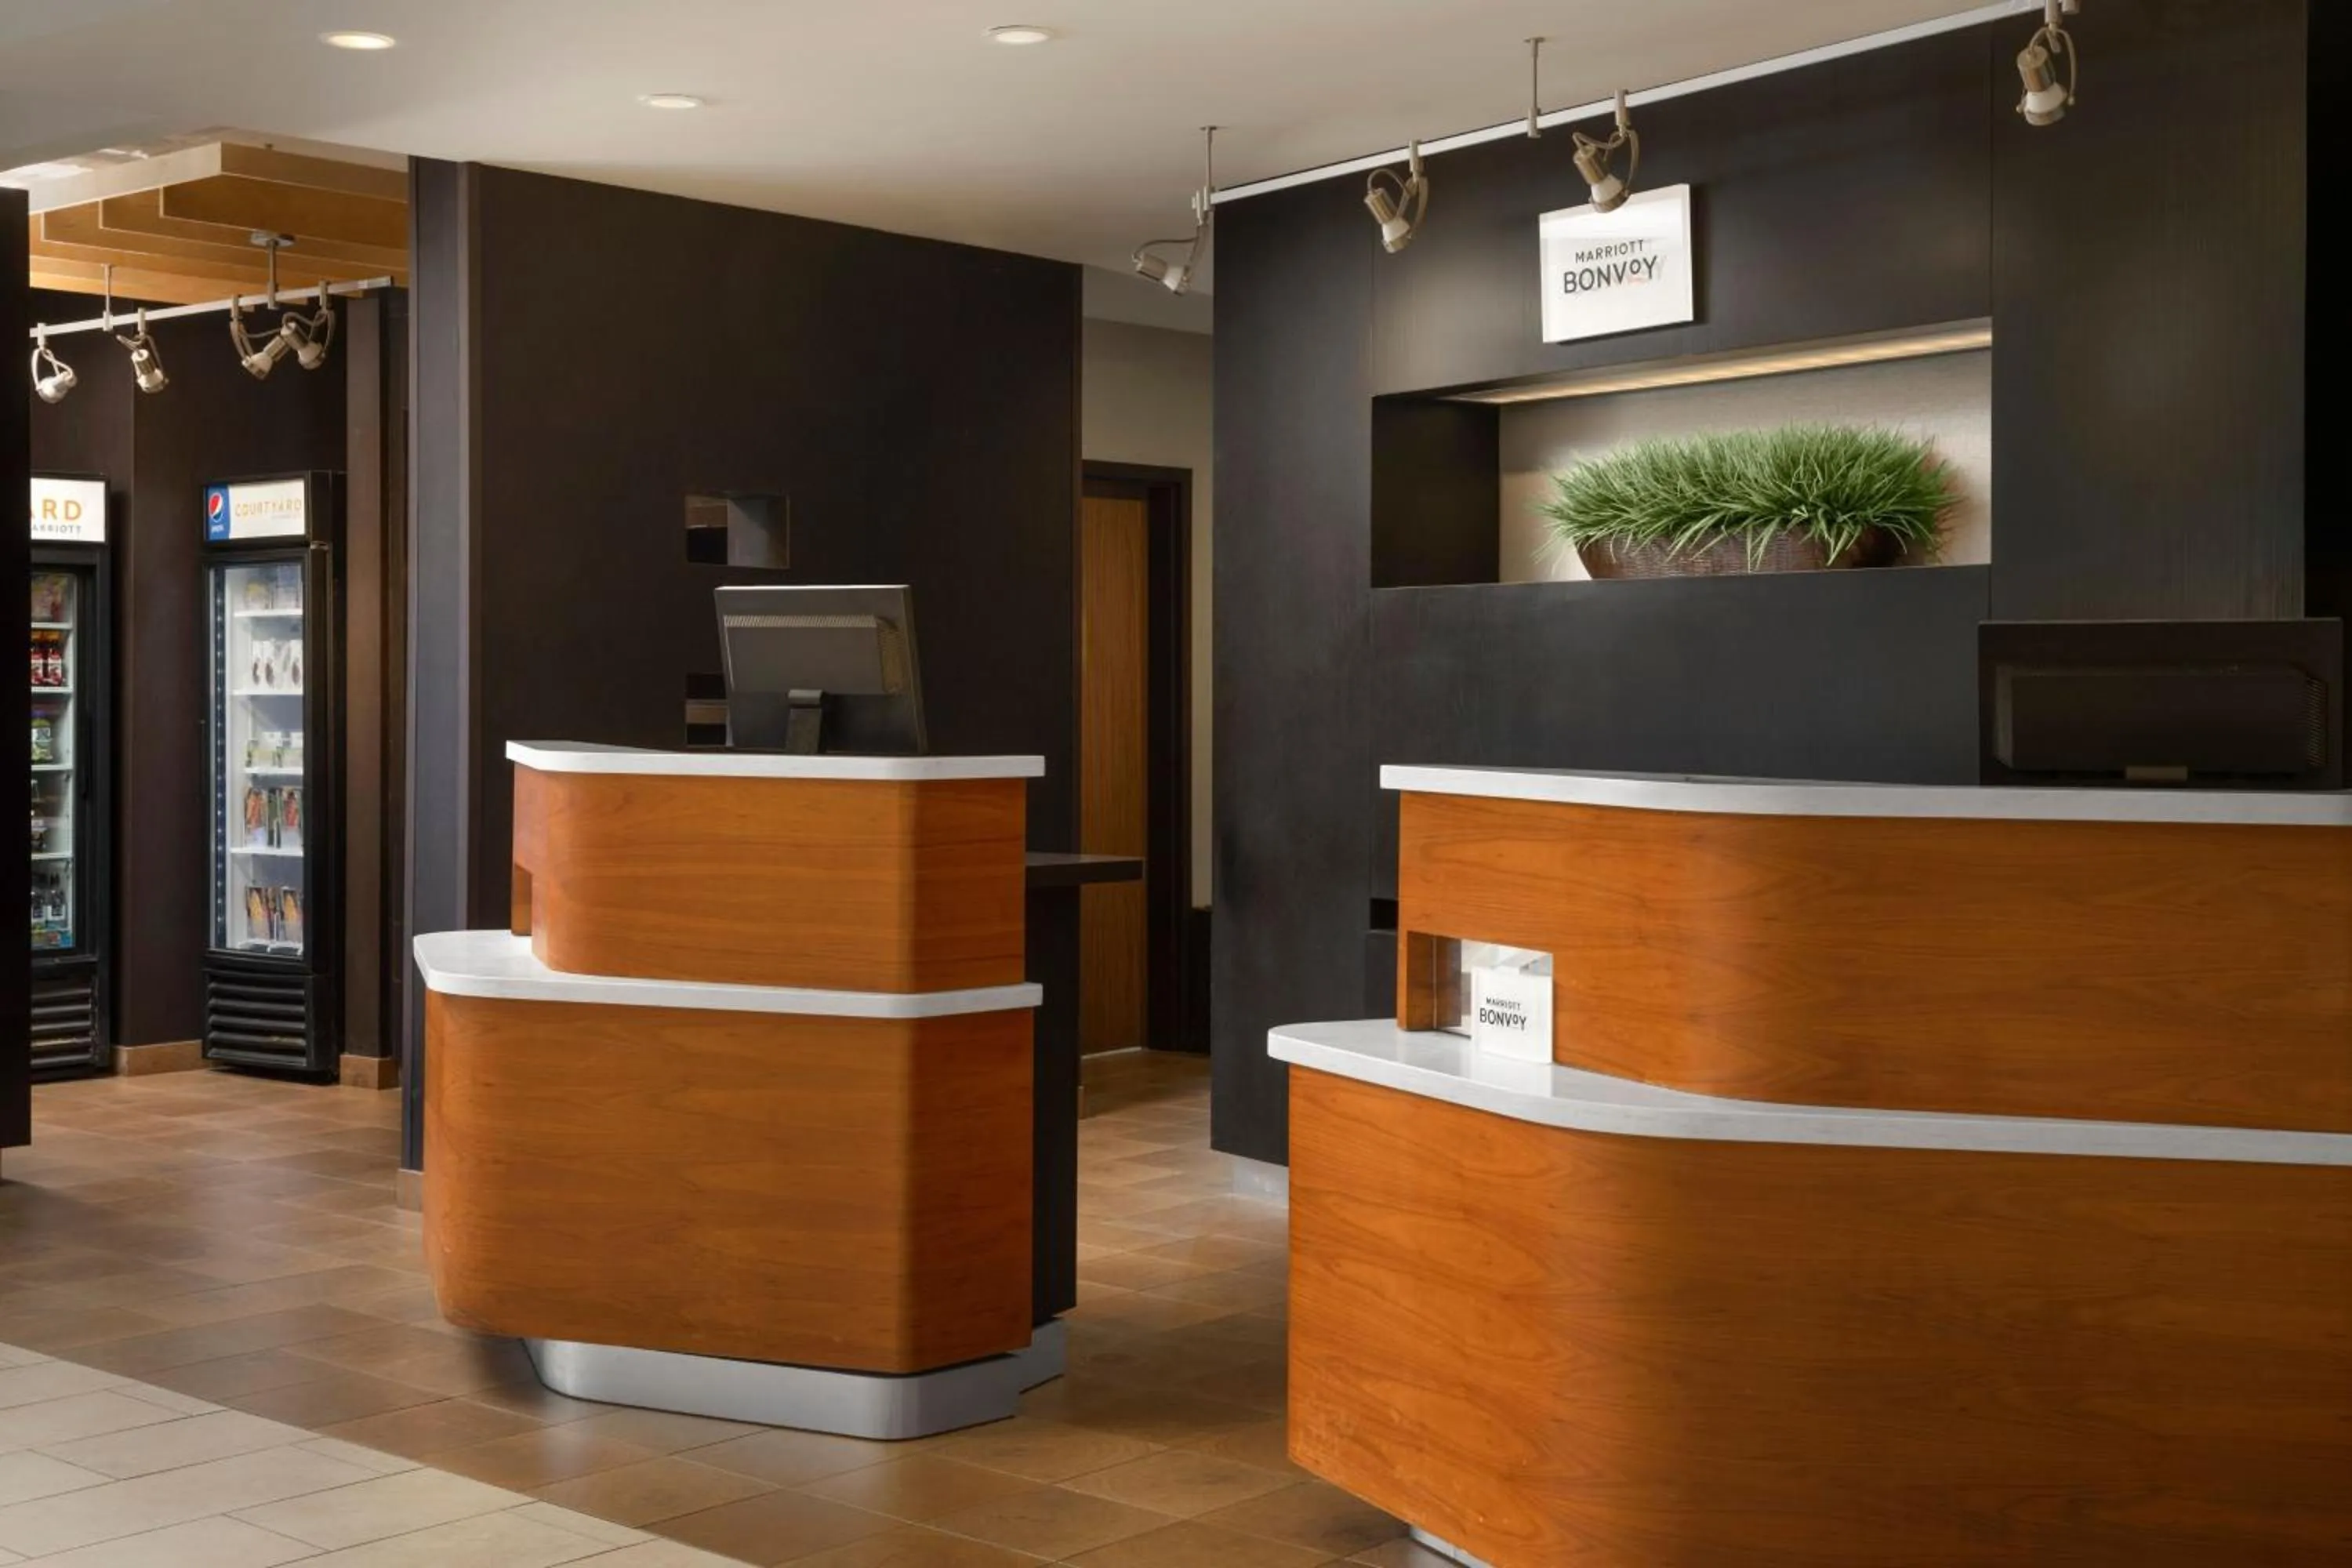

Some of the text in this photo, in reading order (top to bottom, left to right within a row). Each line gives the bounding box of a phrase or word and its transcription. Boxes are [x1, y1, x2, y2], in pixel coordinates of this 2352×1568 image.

[1575, 239, 1644, 264] MARRIOTT
[1563, 255, 1657, 295] BONVOY
[31, 524, 82, 534] ARRIOTT
[1486, 996, 1521, 1011] MARRIOTT
[1479, 1007, 1527, 1032] BONVOY
